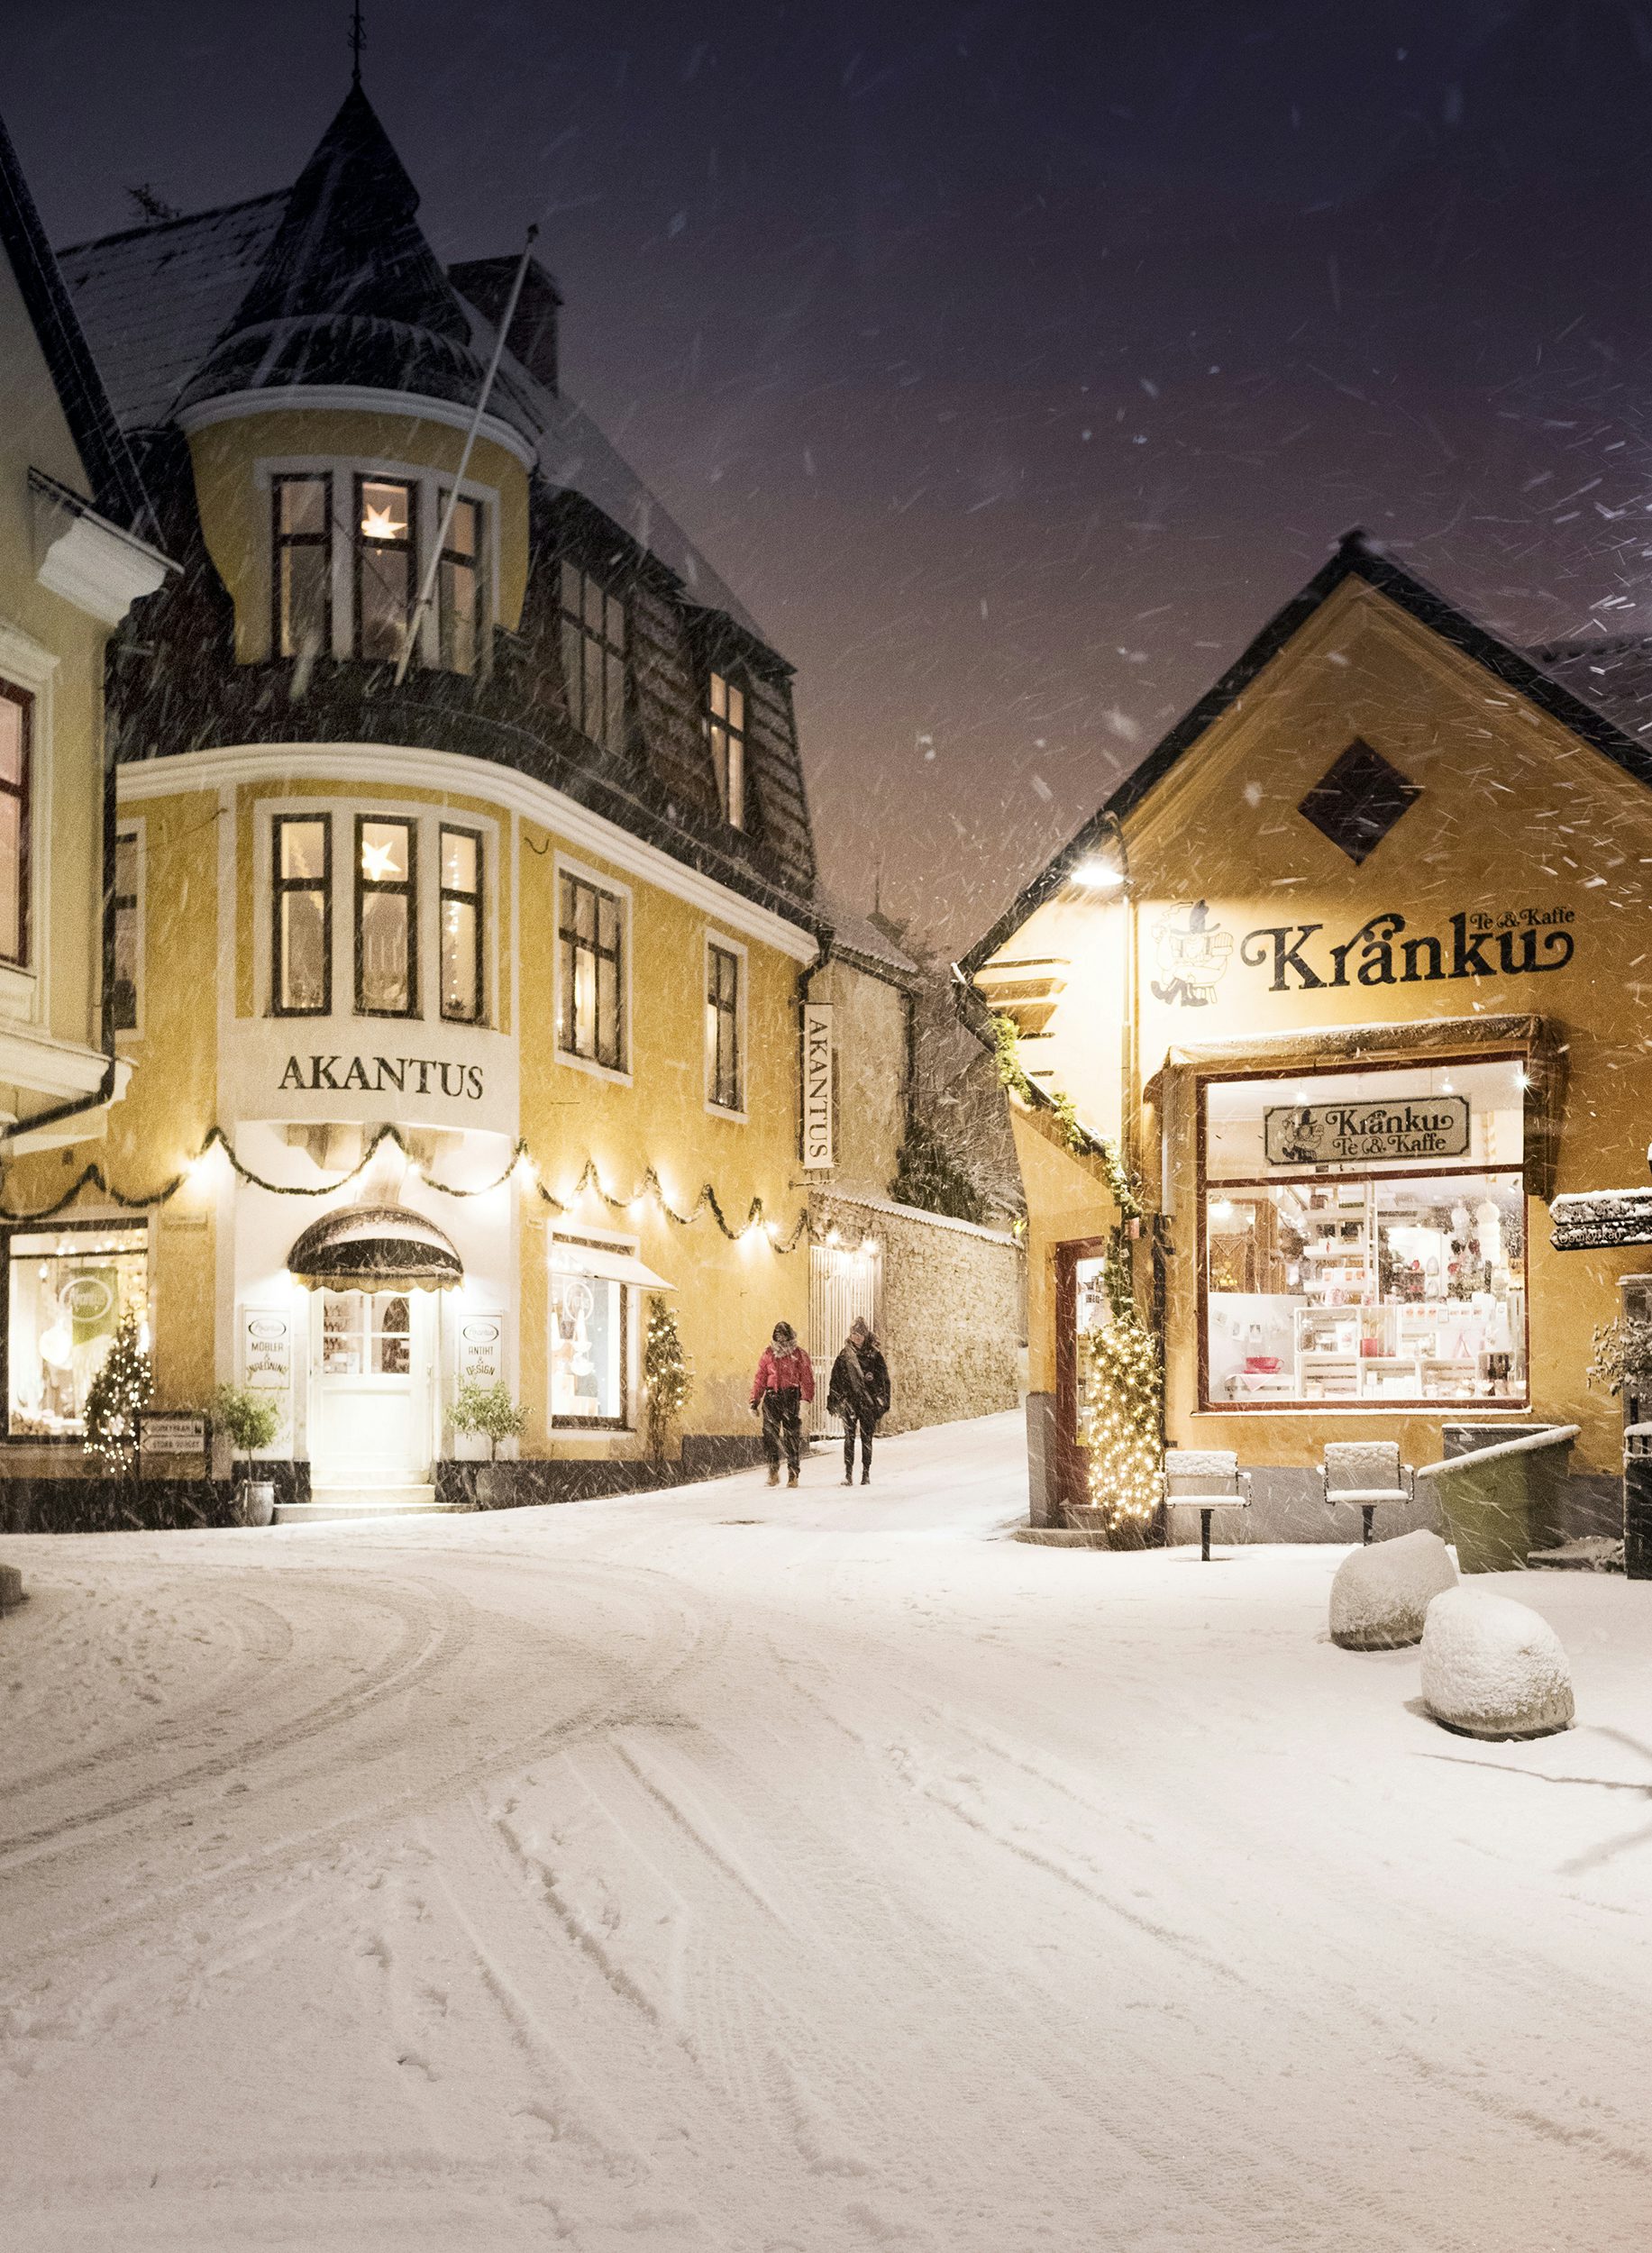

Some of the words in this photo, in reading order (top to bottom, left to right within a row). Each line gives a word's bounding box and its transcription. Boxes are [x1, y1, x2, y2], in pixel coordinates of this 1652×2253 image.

[1470, 913, 1494, 931] Te
[1496, 912, 1520, 929] &
[1522, 907, 1576, 926] Kaffe
[1240, 912, 1576, 992] Kränku
[278, 1055, 484, 1100] AKANTUS
[809, 1017, 828, 1158] AKANTUS
[1325, 1106, 1454, 1137] Kränku
[1332, 1136, 1359, 1156] Te
[1361, 1136, 1387, 1155] &
[1387, 1132, 1447, 1154] Kaffe
[465, 1364, 496, 1377] DESIGN
